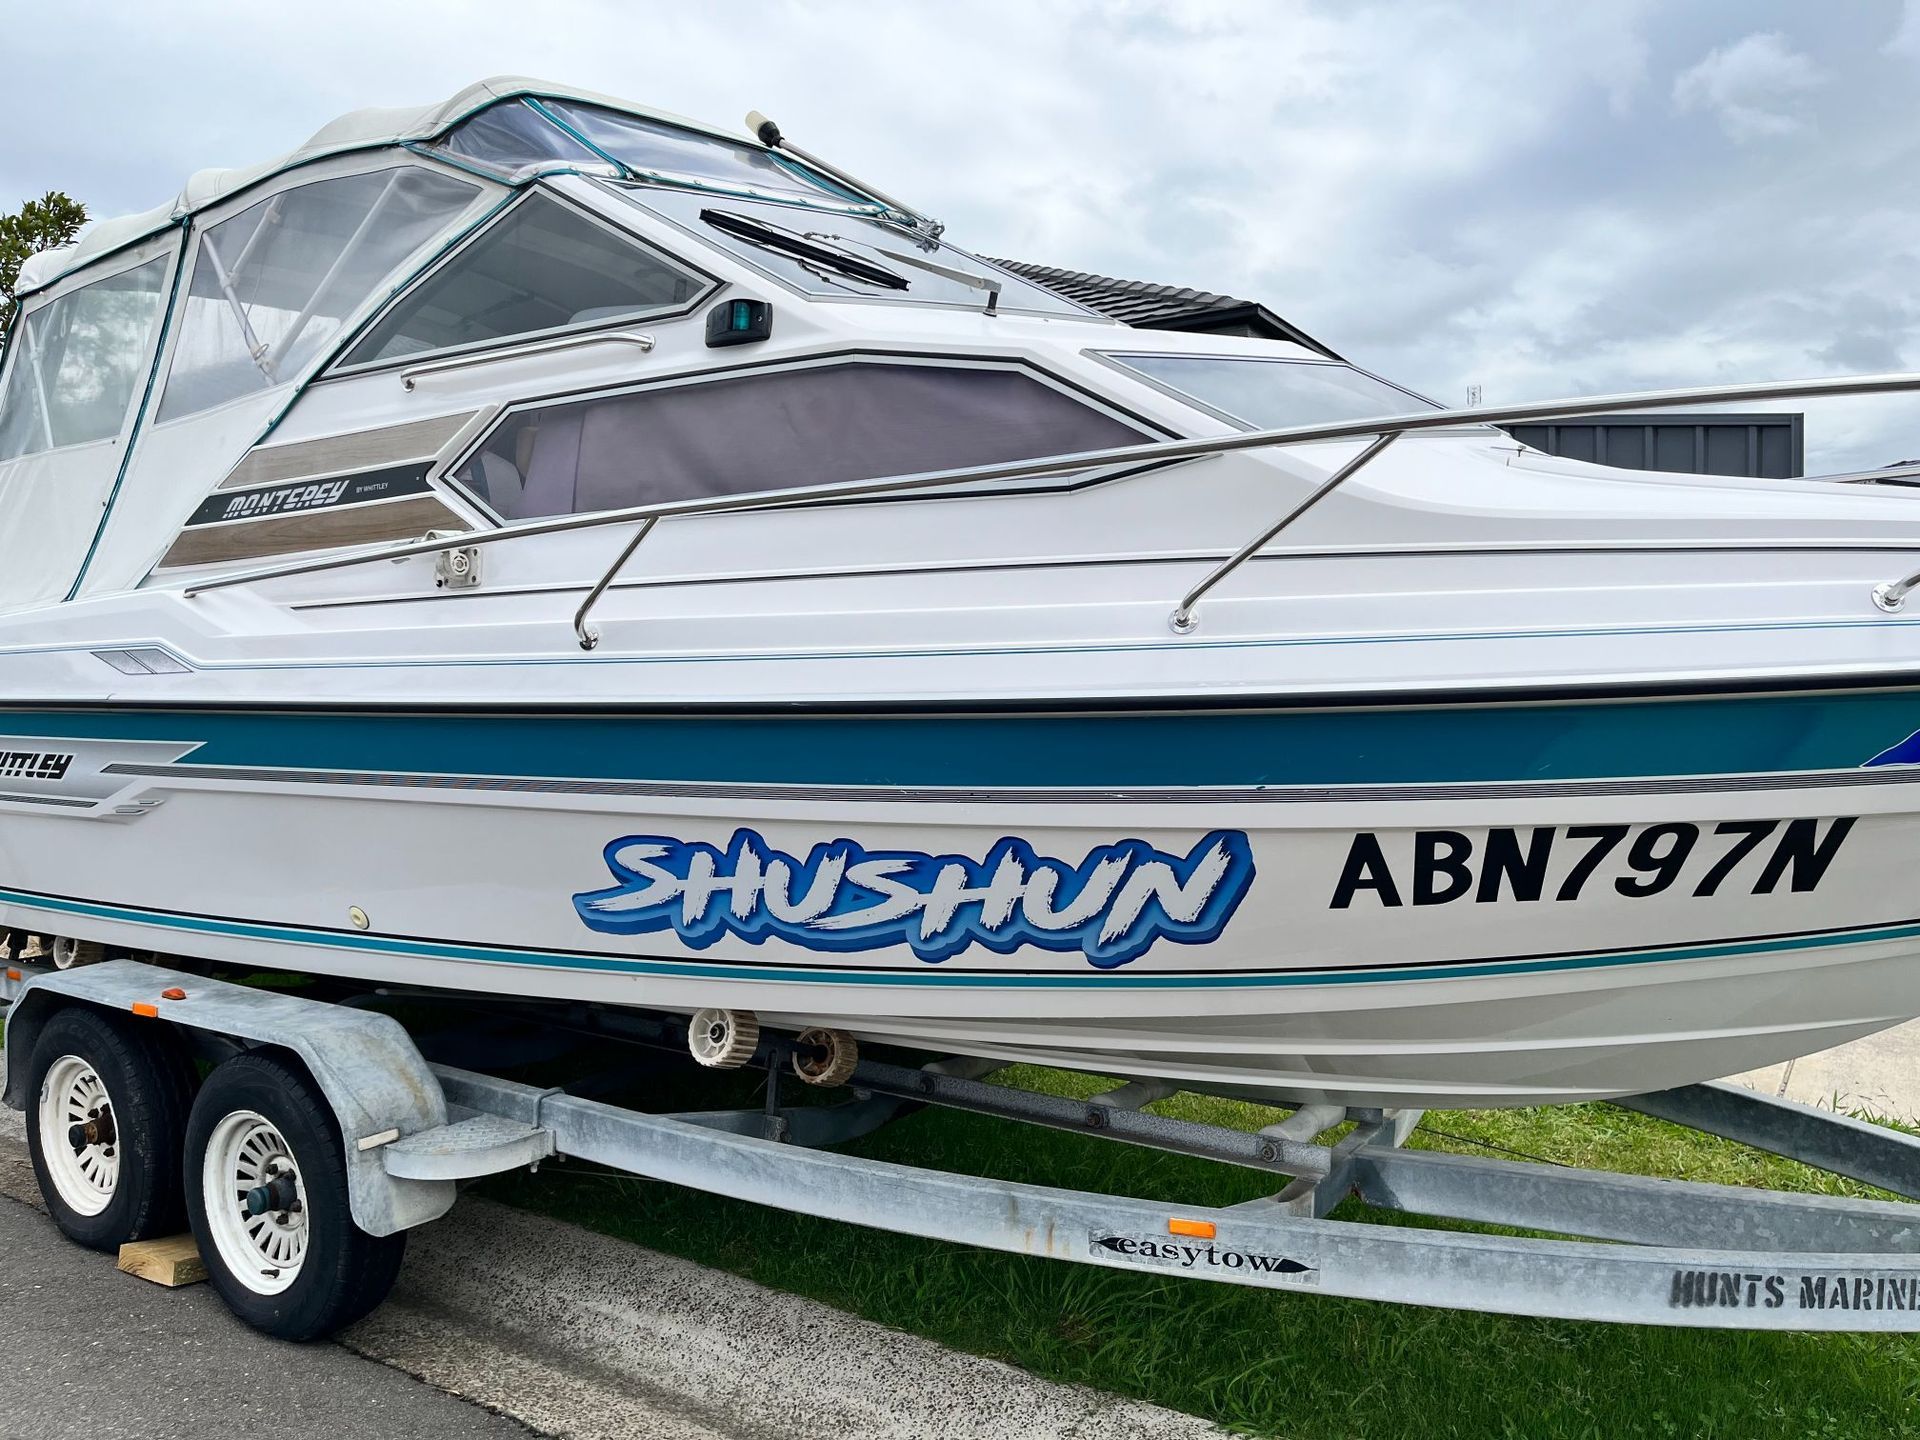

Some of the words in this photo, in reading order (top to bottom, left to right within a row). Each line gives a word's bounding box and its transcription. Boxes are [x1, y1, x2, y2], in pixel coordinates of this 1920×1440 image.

[222, 479, 350, 519] MONTEREY
[356, 486, 364, 494] BY
[1328, 816, 1860, 909] ABN797N
[584, 831, 1232, 949] SHUSHUN
[1118, 1237, 1283, 1273] easytow
[1669, 1270, 1785, 1309] HUNTS
